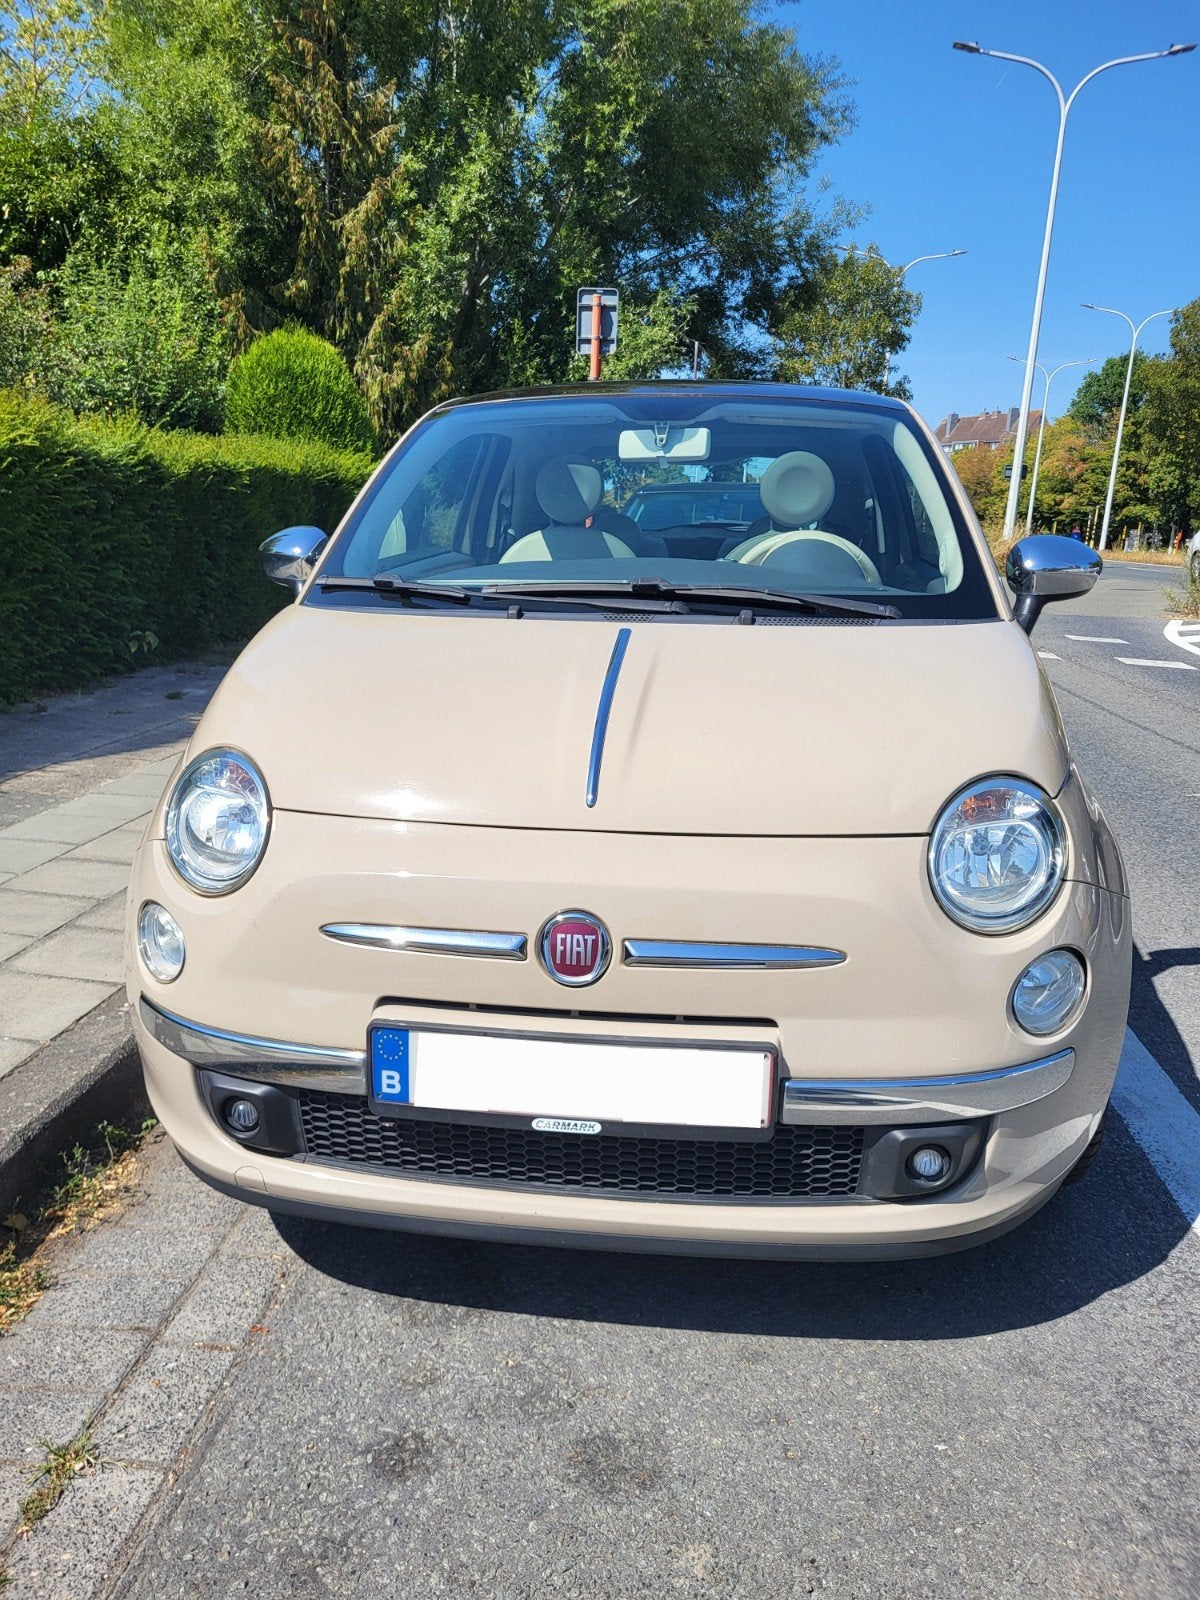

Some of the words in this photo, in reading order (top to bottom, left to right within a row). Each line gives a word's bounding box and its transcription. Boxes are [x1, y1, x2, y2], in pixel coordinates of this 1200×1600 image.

[556, 933, 596, 966] FIAT
[381, 1069, 401, 1094] B
[535, 1119, 597, 1132] CARMARK
